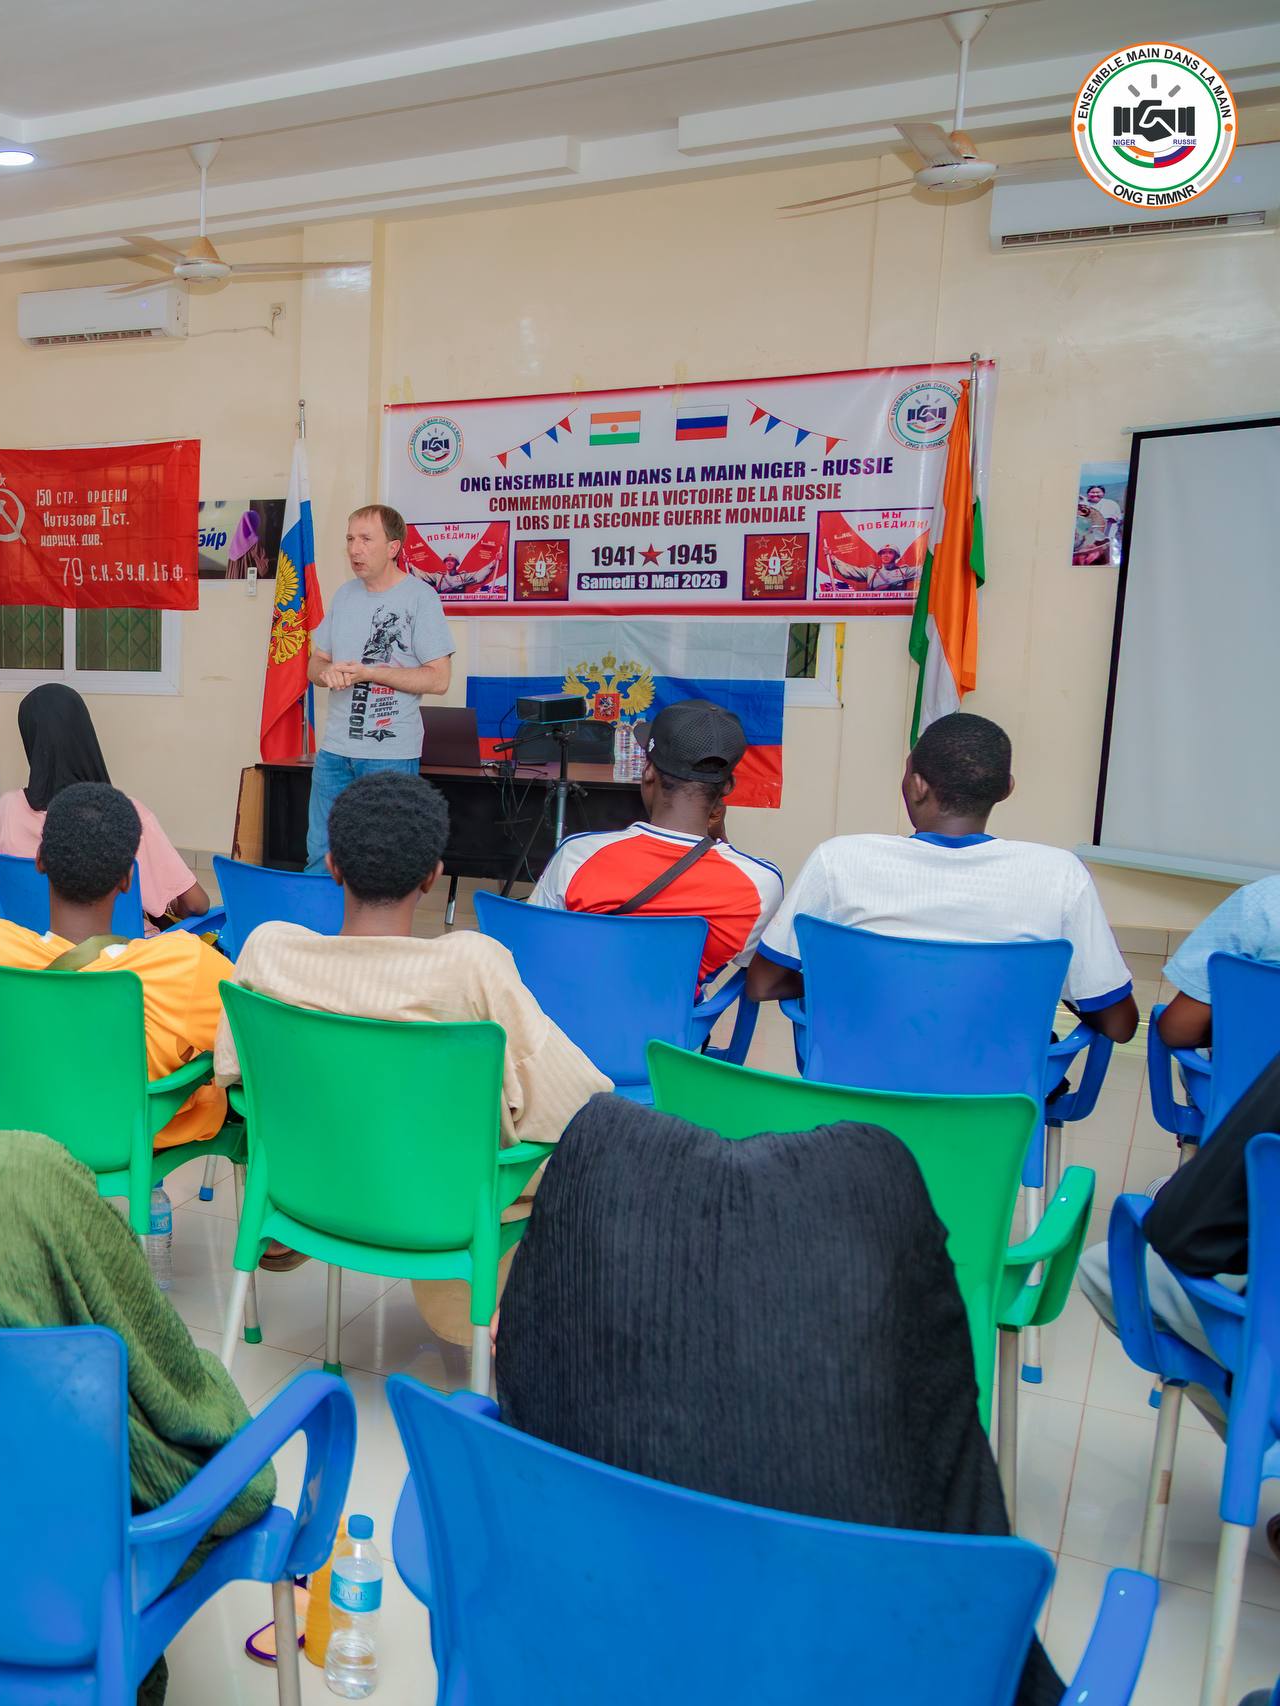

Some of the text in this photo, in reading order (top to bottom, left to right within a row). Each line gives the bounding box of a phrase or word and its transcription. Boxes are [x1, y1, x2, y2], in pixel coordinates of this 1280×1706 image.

[461, 477, 491, 493] ONG
[495, 473, 574, 491] ENSEMBLE
[578, 471, 621, 487] MAIN
[626, 468, 672, 485] DANS
[676, 467, 696, 483] LA
[700, 464, 747, 482] MAIN
[751, 461, 806, 479] NIGER
[823, 457, 894, 477] RUSSIE
[36, 489, 52, 506] 150
[87, 489, 128, 503] ОРДЕНА
[489, 483, 843, 512] COMMEMORATION DE LA VICTOIRE DE LA RUSSIE
[516, 506, 806, 531] LORS DE LA SECONDE GUERRE MONDIALE
[858, 520, 929, 532] ПОБЕДИЛИ!
[198, 528, 227, 550] эйр
[427, 533, 480, 542] ПОБЕДИЛИ!
[592, 544, 717, 567] 1941 1945
[769, 557, 781, 576] 9
[59, 558, 84, 587] 79
[535, 560, 546, 578] 9
[581, 574, 721, 590] Samedi 9 Mai 2026
[349, 681, 372, 740] ПОБЕД
